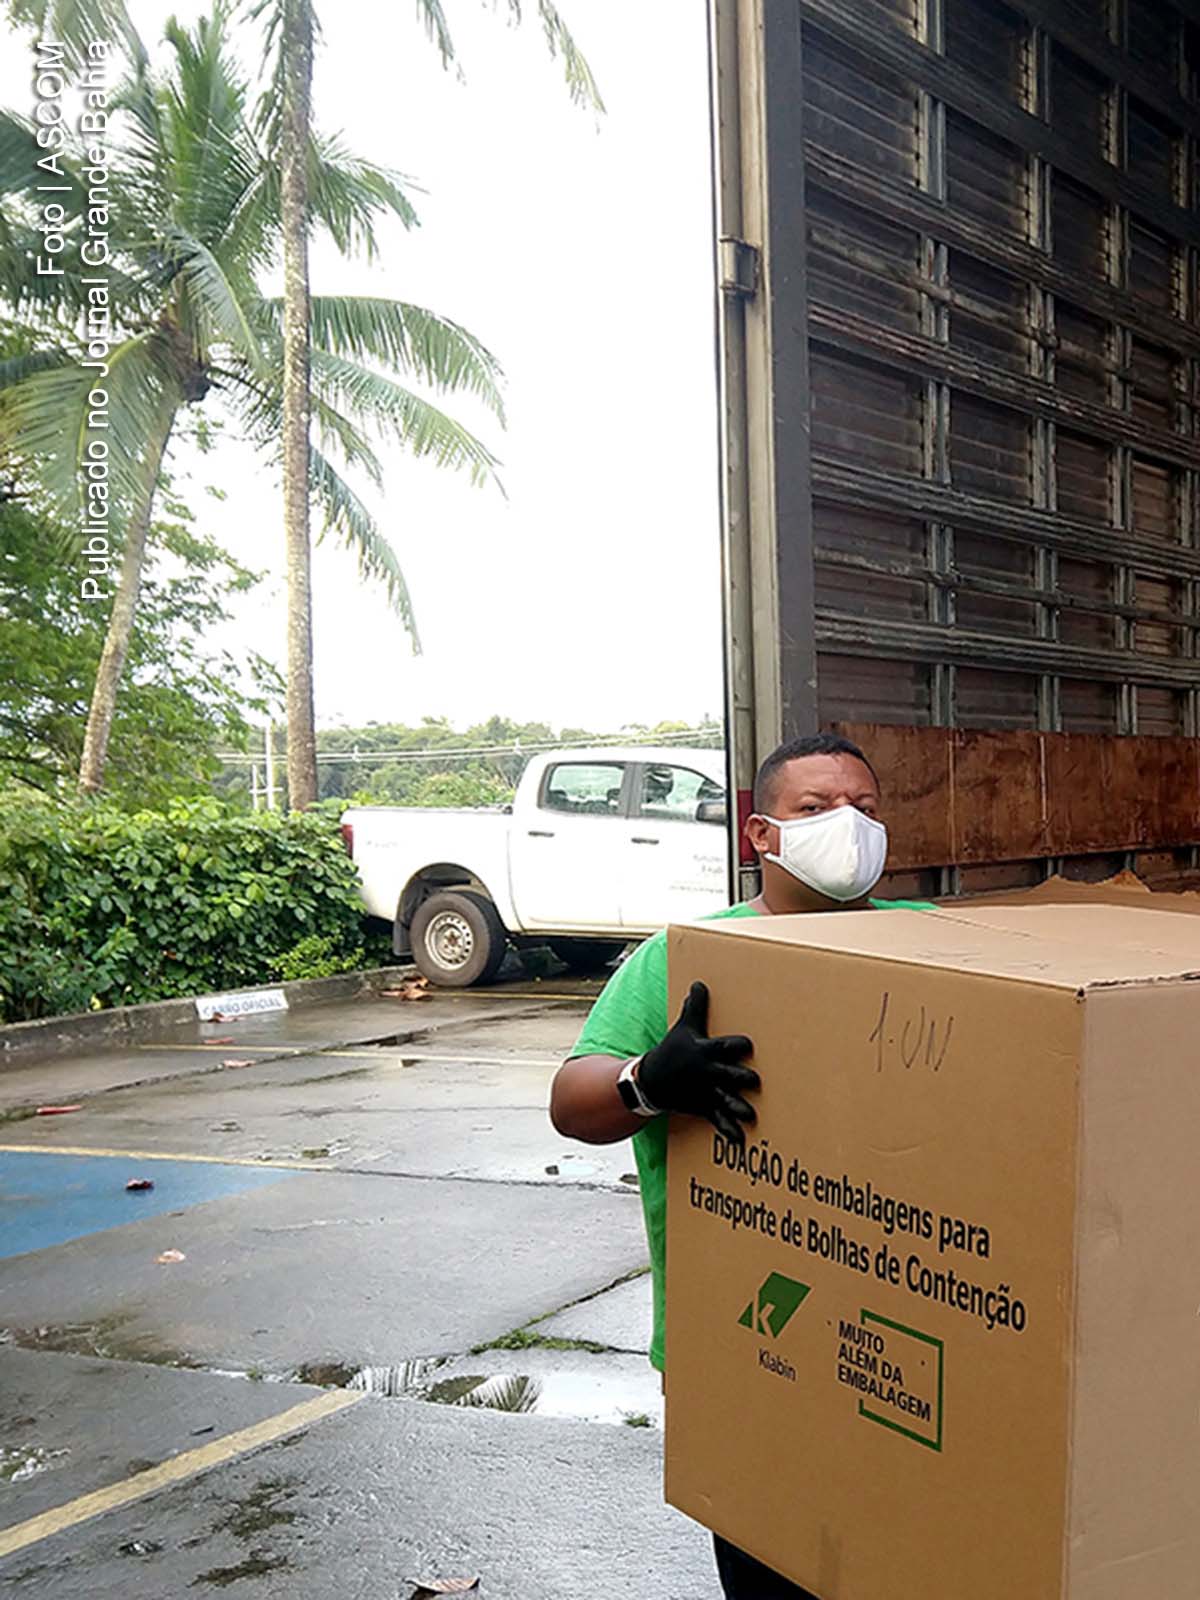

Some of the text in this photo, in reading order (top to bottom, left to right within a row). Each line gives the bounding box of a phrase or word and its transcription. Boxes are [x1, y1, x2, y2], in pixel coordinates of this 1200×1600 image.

[713, 1133, 990, 1259] DOAÇÃO de embalagens para
[689, 1175, 1025, 1332] transporte de Bolhas de Contenção
[838, 1320, 884, 1355] MUITO
[759, 1347, 797, 1382] Klabin
[838, 1342, 904, 1387] ALÉM DA
[837, 1363, 931, 1422] EMBALAGEM
